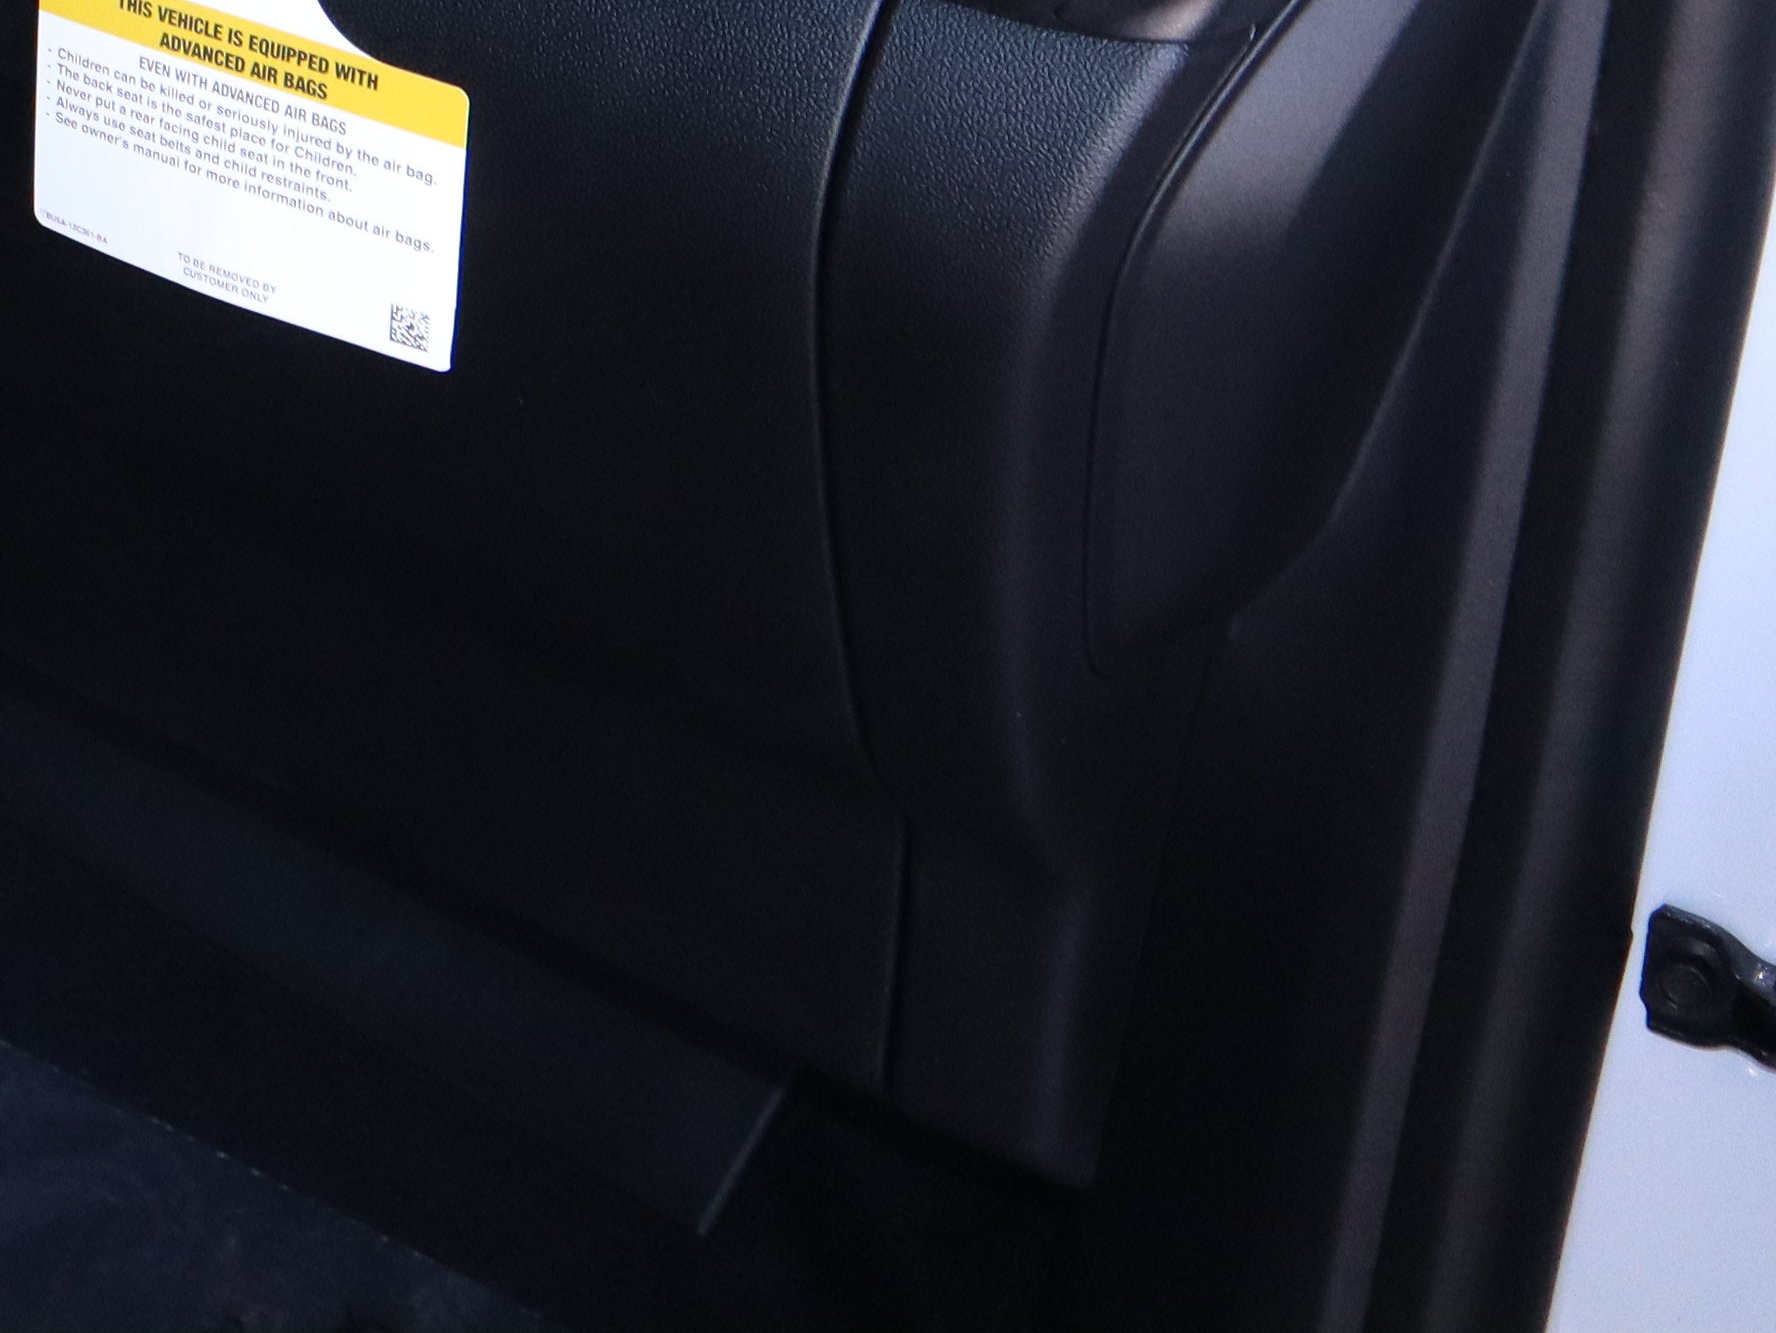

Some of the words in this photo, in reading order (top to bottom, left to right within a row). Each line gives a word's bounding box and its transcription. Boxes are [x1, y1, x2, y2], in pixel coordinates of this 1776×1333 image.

[138, 56, 171, 78] EVEN
[174, 67, 208, 90] WITH
[211, 79, 280, 113] ADVANCED
[284, 103, 307, 122] AIR
[311, 112, 347, 135] BAGS
[157, 5, 224, 41] VEHICLE
[228, 27, 244, 48] IS
[248, 34, 329, 75] EQUIPPED
[335, 62, 379, 91] WITH
[159, 31, 246, 73] ADVANCED
[250, 61, 278, 84] AIR
[283, 72, 328, 100] BAGS
[55, 95, 100, 121] Always
[103, 114, 126, 130] use
[129, 124, 156, 141] seat
[159, 133, 191, 154] belts
[194, 148, 221, 164] and
[223, 157, 257, 176] child
[260, 170, 331, 200] restraints.
[56, 78, 92, 101] Never
[95, 95, 116, 110] put
[119, 104, 127, 114] a
[130, 108, 156, 125] rear
[159, 116, 199, 143] facing
[202, 133, 236, 152] child
[239, 146, 269, 164] seat
[272, 154, 286, 169] in
[289, 160, 312, 177] the
[315, 168, 353, 191] front.
[57, 47, 110, 76] Children
[113, 69, 136, 85] can
[140, 76, 156, 92] be
[159, 83, 195, 105] killed
[198, 99, 213, 111] or
[216, 104, 279, 135] seriously
[283, 124, 332, 150] injured
[335, 141, 353, 159] by
[357, 148, 379, 165] the
[383, 158, 402, 173] air
[406, 164, 438, 185] bag.
[57, 63, 79, 81] The
[83, 72, 113, 93] back
[116, 87, 143, 104] seat
[146, 95, 157, 109] is
[161, 100, 182, 117] the
[185, 111, 227, 132] safest
[230, 125, 267, 146] place
[270, 137, 291, 153] for
[294, 144, 358, 175] Children.
[55, 110, 78, 128] See
[80, 122, 130, 148] owner's
[132, 142, 180, 167] manual
[183, 158, 203, 175] for
[205, 168, 240, 188] more
[243, 179, 324, 216] information
[327, 210, 369, 231] about
[372, 224, 390, 238] air
[395, 229, 435, 252] bags.
